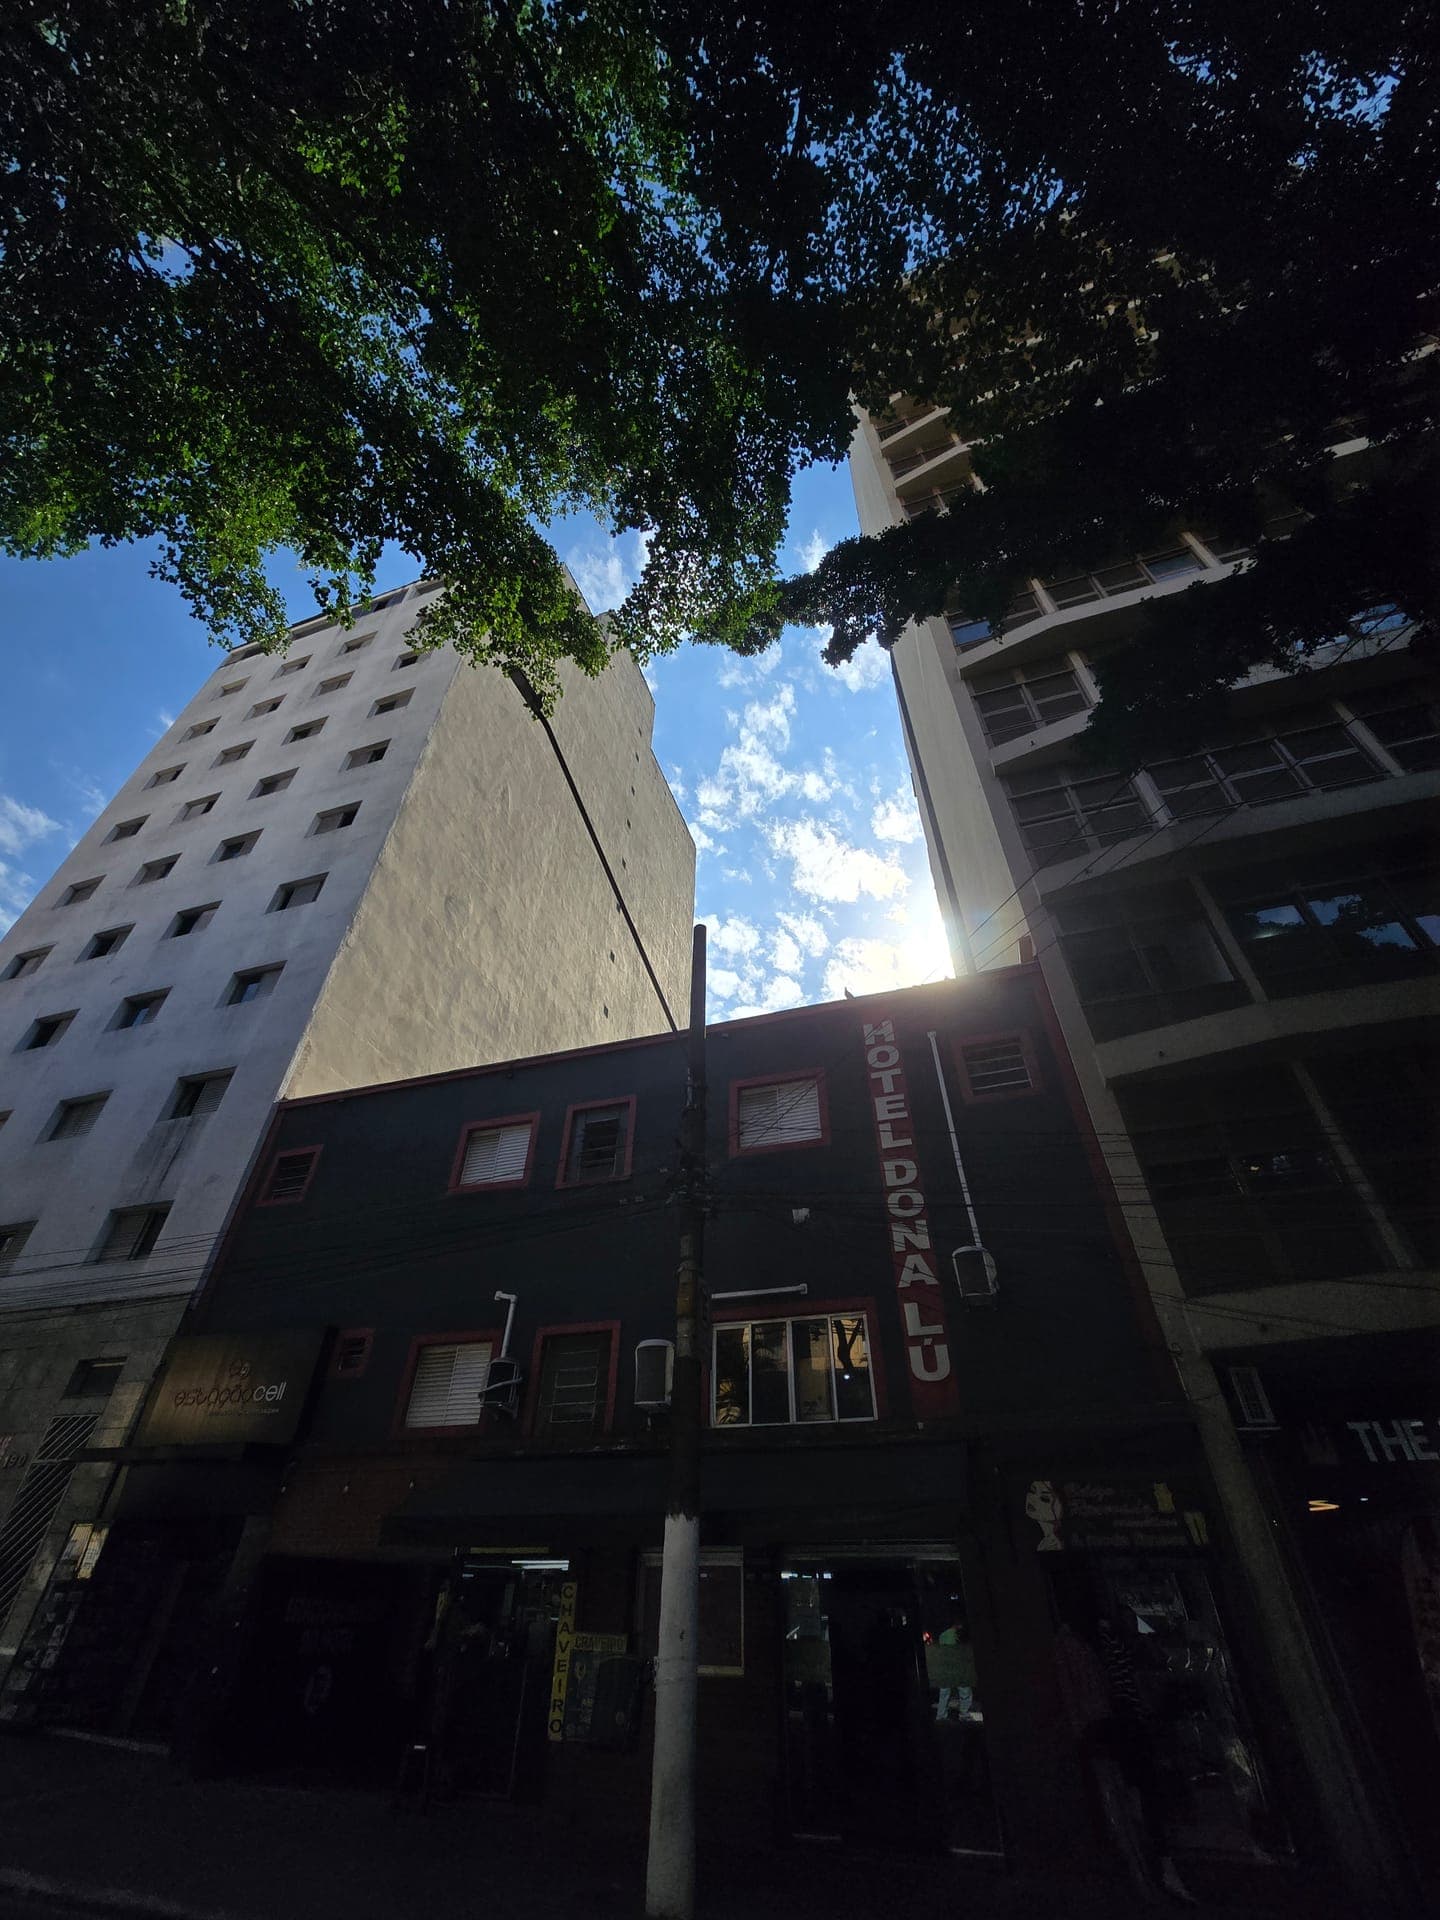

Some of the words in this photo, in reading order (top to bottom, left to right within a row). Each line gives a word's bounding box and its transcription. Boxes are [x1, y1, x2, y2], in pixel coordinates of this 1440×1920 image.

[863, 1020, 912, 1149] HOTEL
[882, 1158, 940, 1289] DONA
[903, 1302, 951, 1382] LÚ
[1345, 1419, 1440, 1463] THE
[549, 1585, 574, 1733] CHAVEIRO
